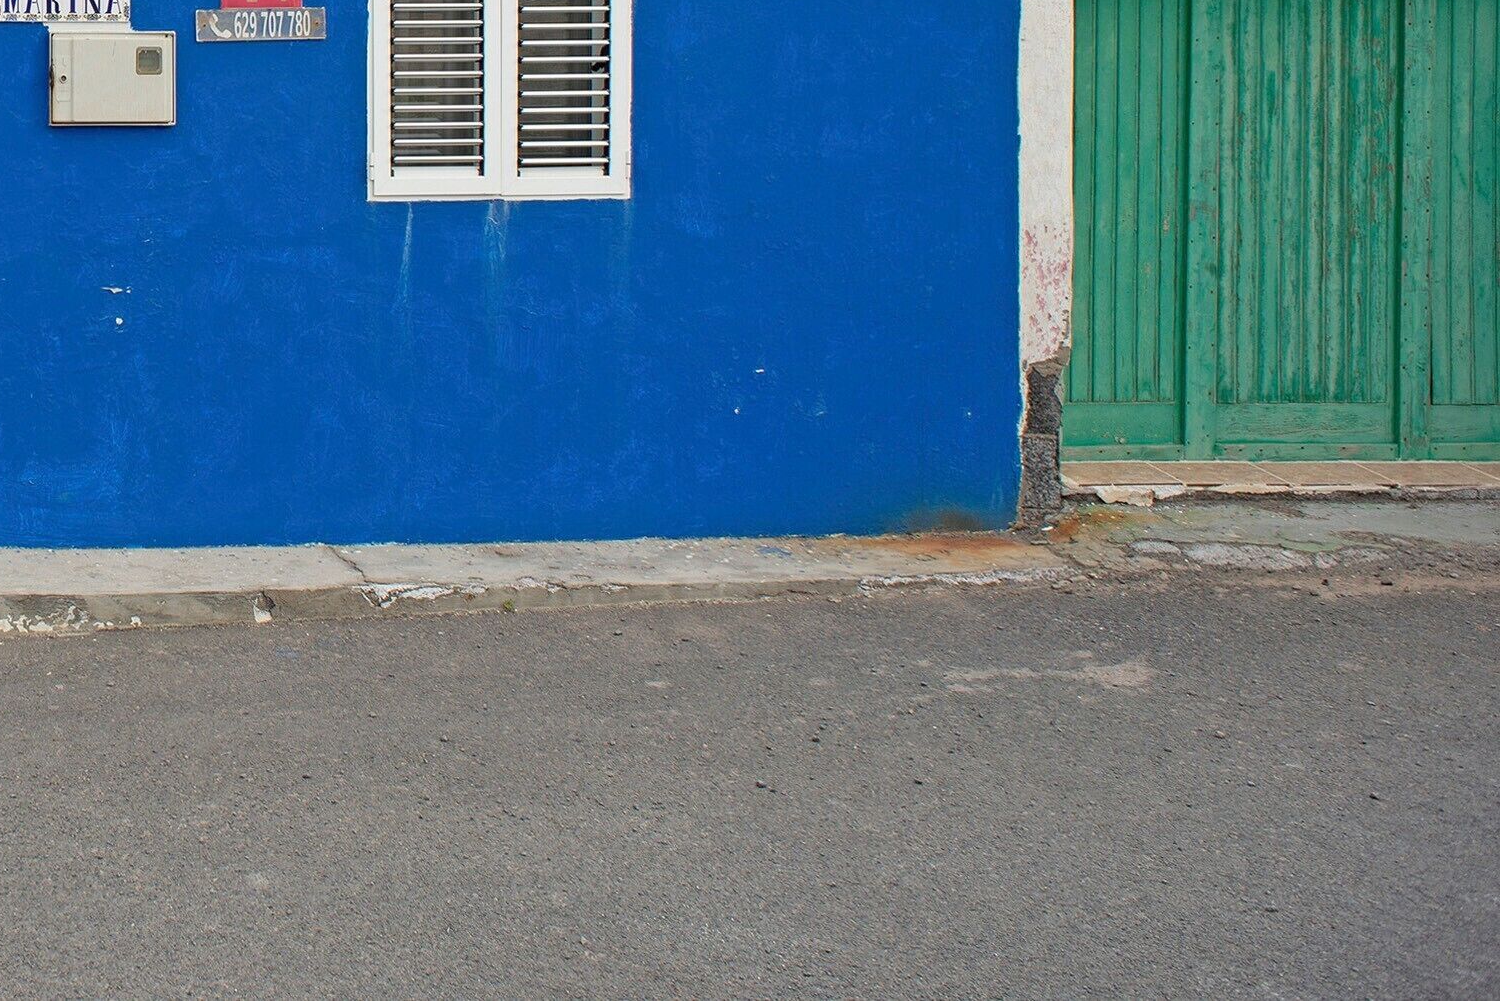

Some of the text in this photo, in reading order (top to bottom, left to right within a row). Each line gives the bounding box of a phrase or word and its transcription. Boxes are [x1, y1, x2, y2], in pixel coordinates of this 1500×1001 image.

[234, 10, 311, 38] 629 707 780
